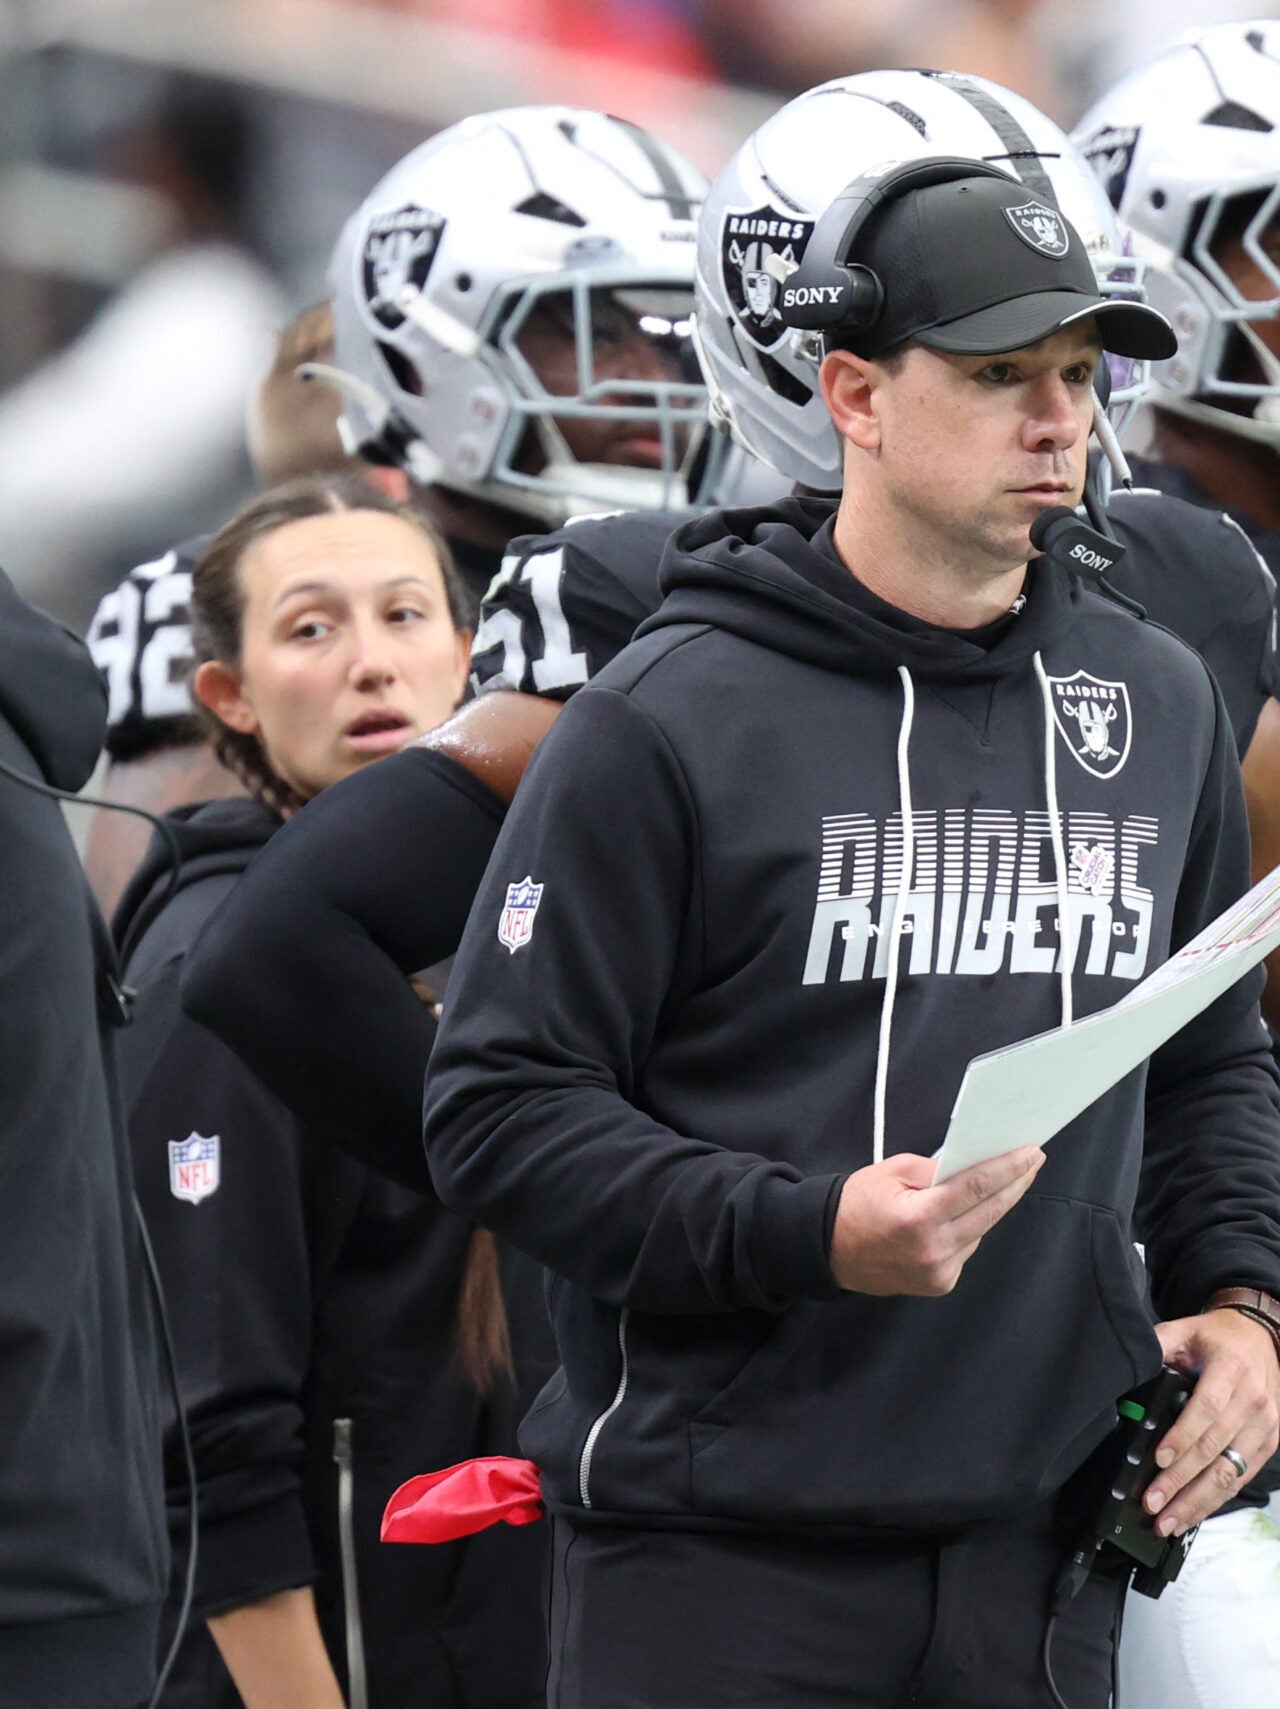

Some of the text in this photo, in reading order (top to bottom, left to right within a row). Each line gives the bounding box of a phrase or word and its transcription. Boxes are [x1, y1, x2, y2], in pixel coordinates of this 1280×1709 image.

[1015, 208, 1057, 219] RAIDERS
[729, 217, 805, 240] RAIDERS
[783, 286, 845, 307] SONY
[1068, 543, 1114, 572] SONY
[86, 572, 196, 727] 92
[1055, 683, 1118, 700] RAIDERS
[801, 807, 1160, 986] RAIDERS
[502, 909, 529, 940] NFL
[841, 918, 1062, 941] ENGINEERE
[178, 1162, 213, 1192] NFL
